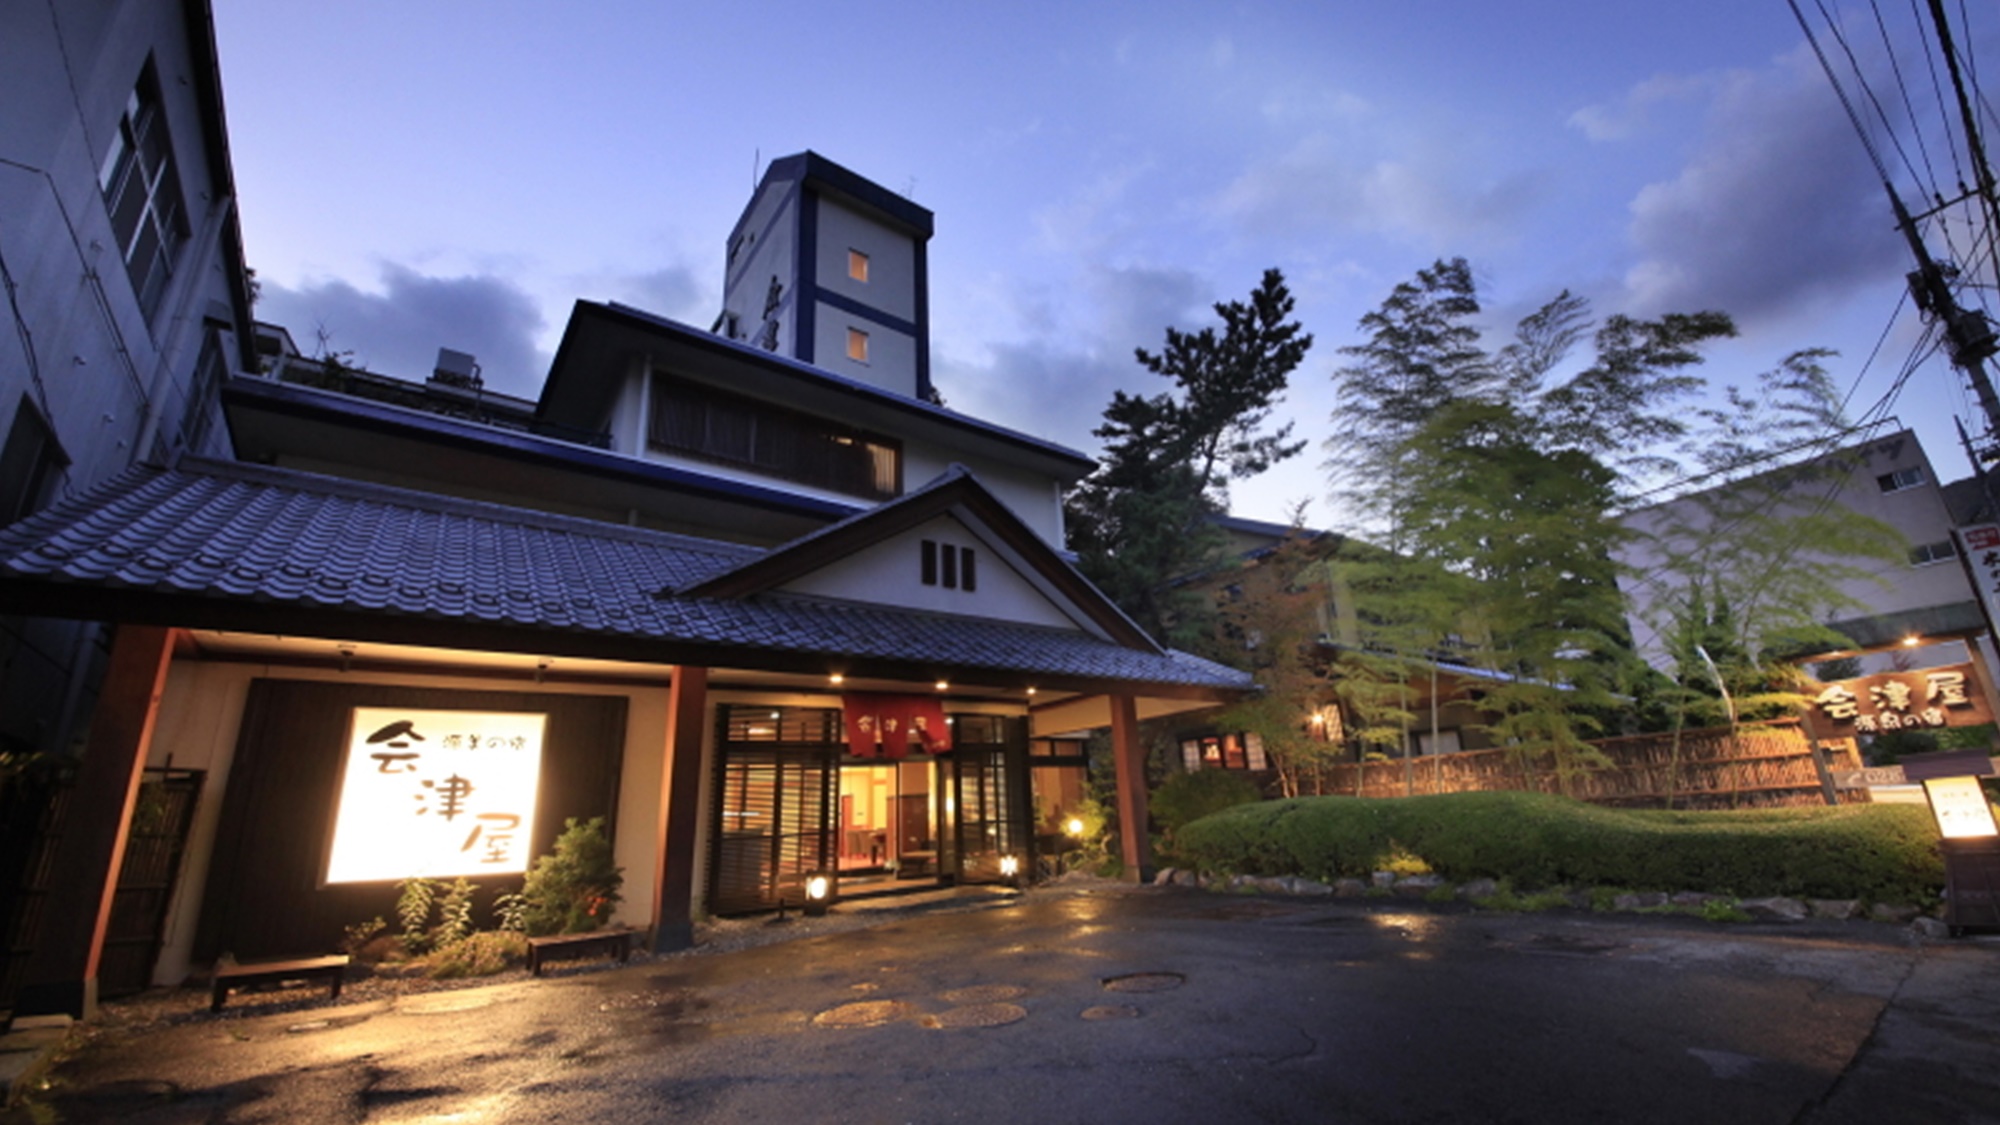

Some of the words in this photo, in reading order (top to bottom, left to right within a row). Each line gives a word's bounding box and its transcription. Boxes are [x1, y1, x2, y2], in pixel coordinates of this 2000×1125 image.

[1815, 672, 1969, 719] 会津屋
[365, 720, 521, 864] 会津屋
